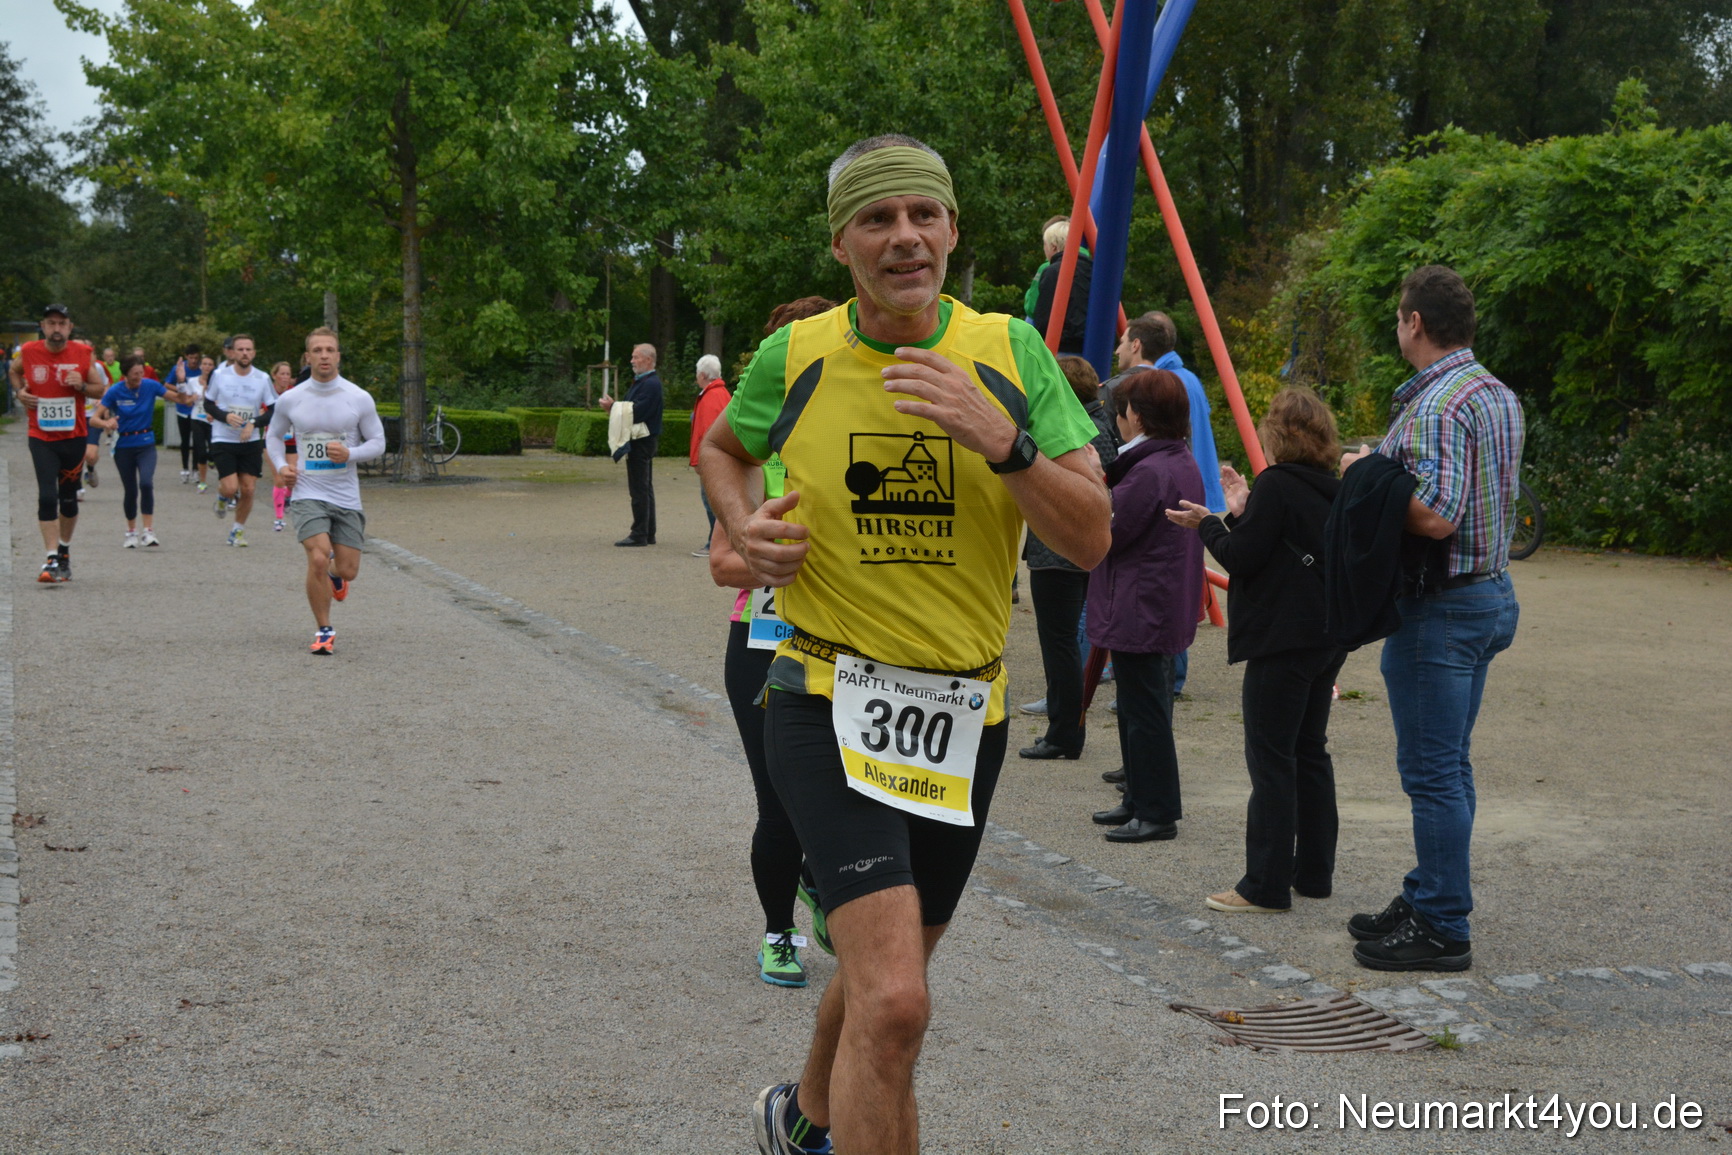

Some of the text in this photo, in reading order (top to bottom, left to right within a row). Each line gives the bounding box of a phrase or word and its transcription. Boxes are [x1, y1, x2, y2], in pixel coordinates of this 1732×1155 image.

[41, 405, 73, 419] 3315
[307, 443, 329, 459] 28
[855, 517, 954, 538] HIRSCH
[861, 547, 954, 558] APOTHEKE
[837, 669, 890, 692] PARTL
[894, 682, 965, 706] Neumarkt
[860, 698, 953, 764] 300
[864, 761, 947, 801] Alexander
